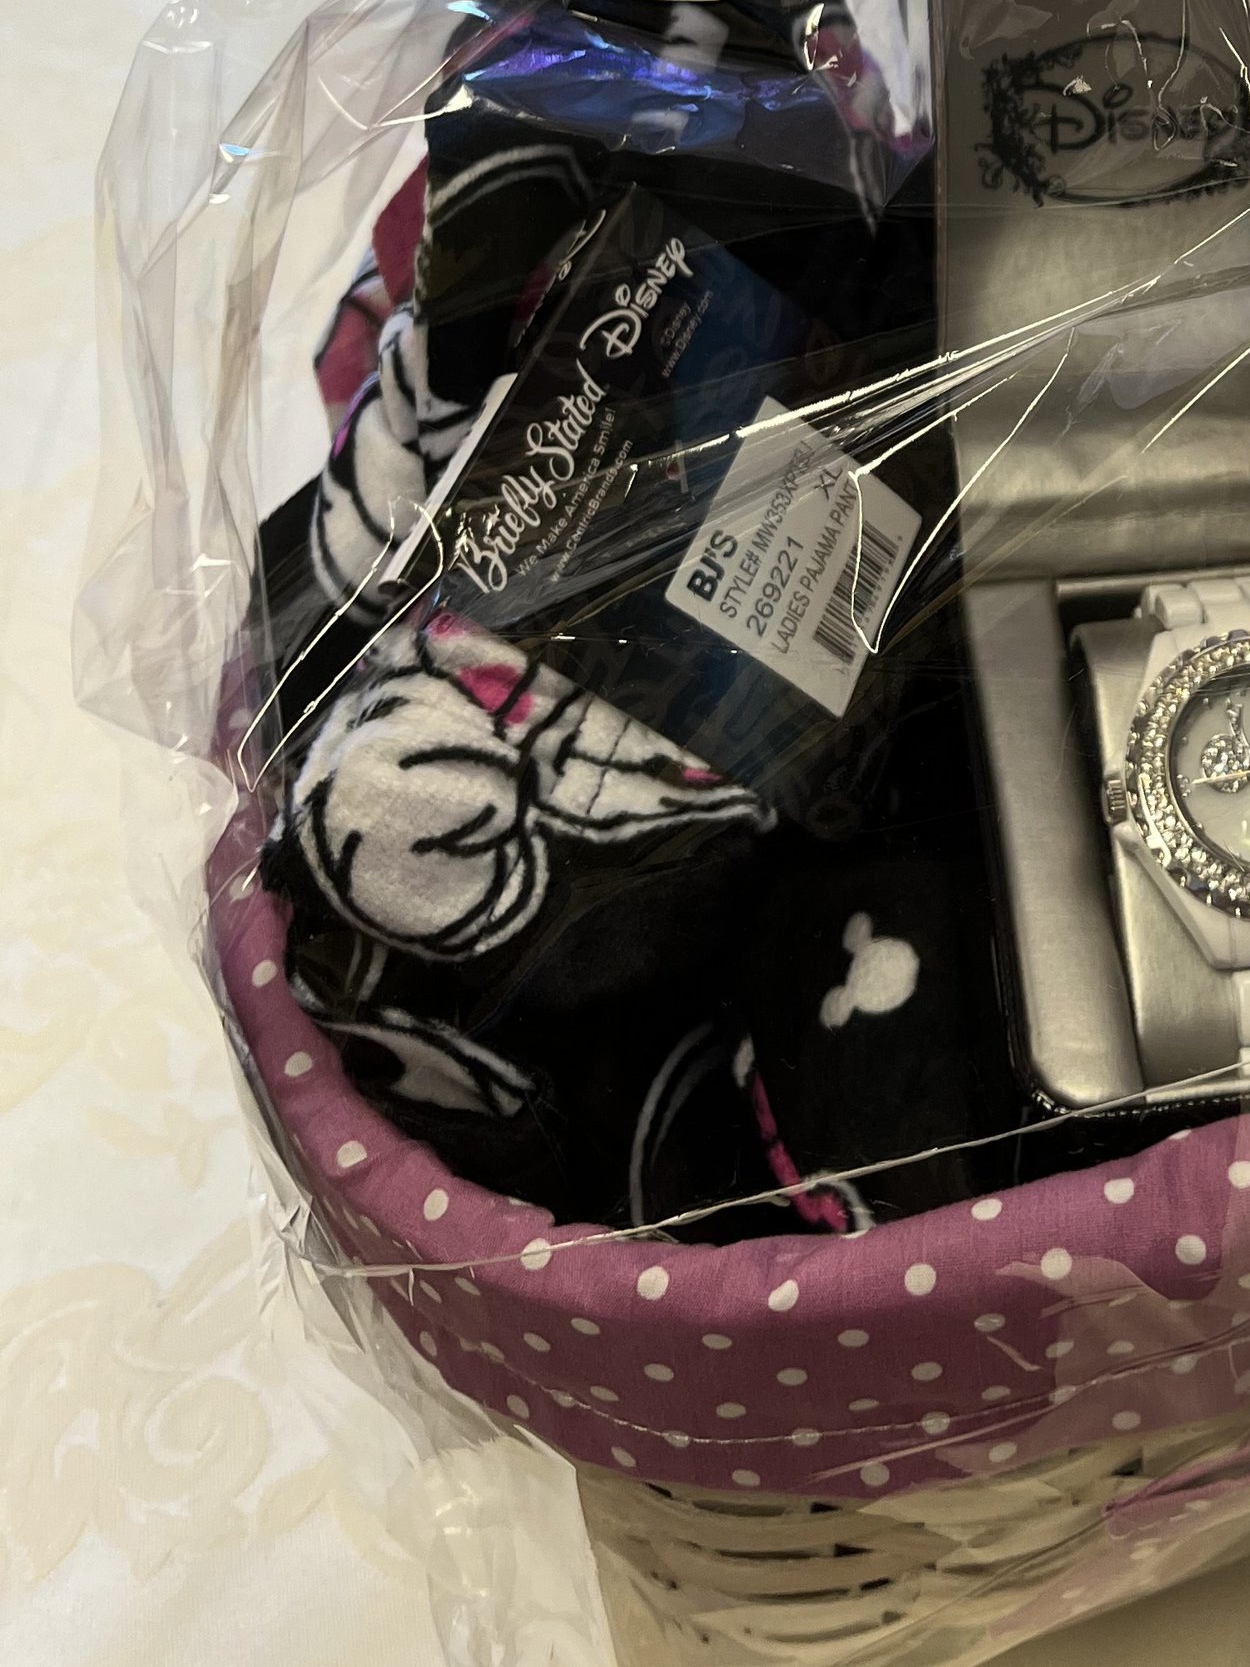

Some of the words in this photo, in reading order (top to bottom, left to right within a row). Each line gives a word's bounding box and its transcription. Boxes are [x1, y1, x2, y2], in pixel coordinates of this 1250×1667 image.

[455, 466, 556, 594] Briefly
[525, 358, 607, 482] Stated
[515, 556, 539, 577] We
[535, 516, 569, 555] Make
[564, 456, 601, 519] America
[593, 406, 617, 456] Smile!
[550, 438, 634, 584] www.CentricBrands.com
[686, 529, 739, 603] BJ'S
[719, 550, 761, 619] STYLE#
[746, 535, 804, 638] 269221
[813, 466, 844, 502] XL
[771, 590, 811, 655] LADIES
[799, 525, 841, 594] PAJAMA
